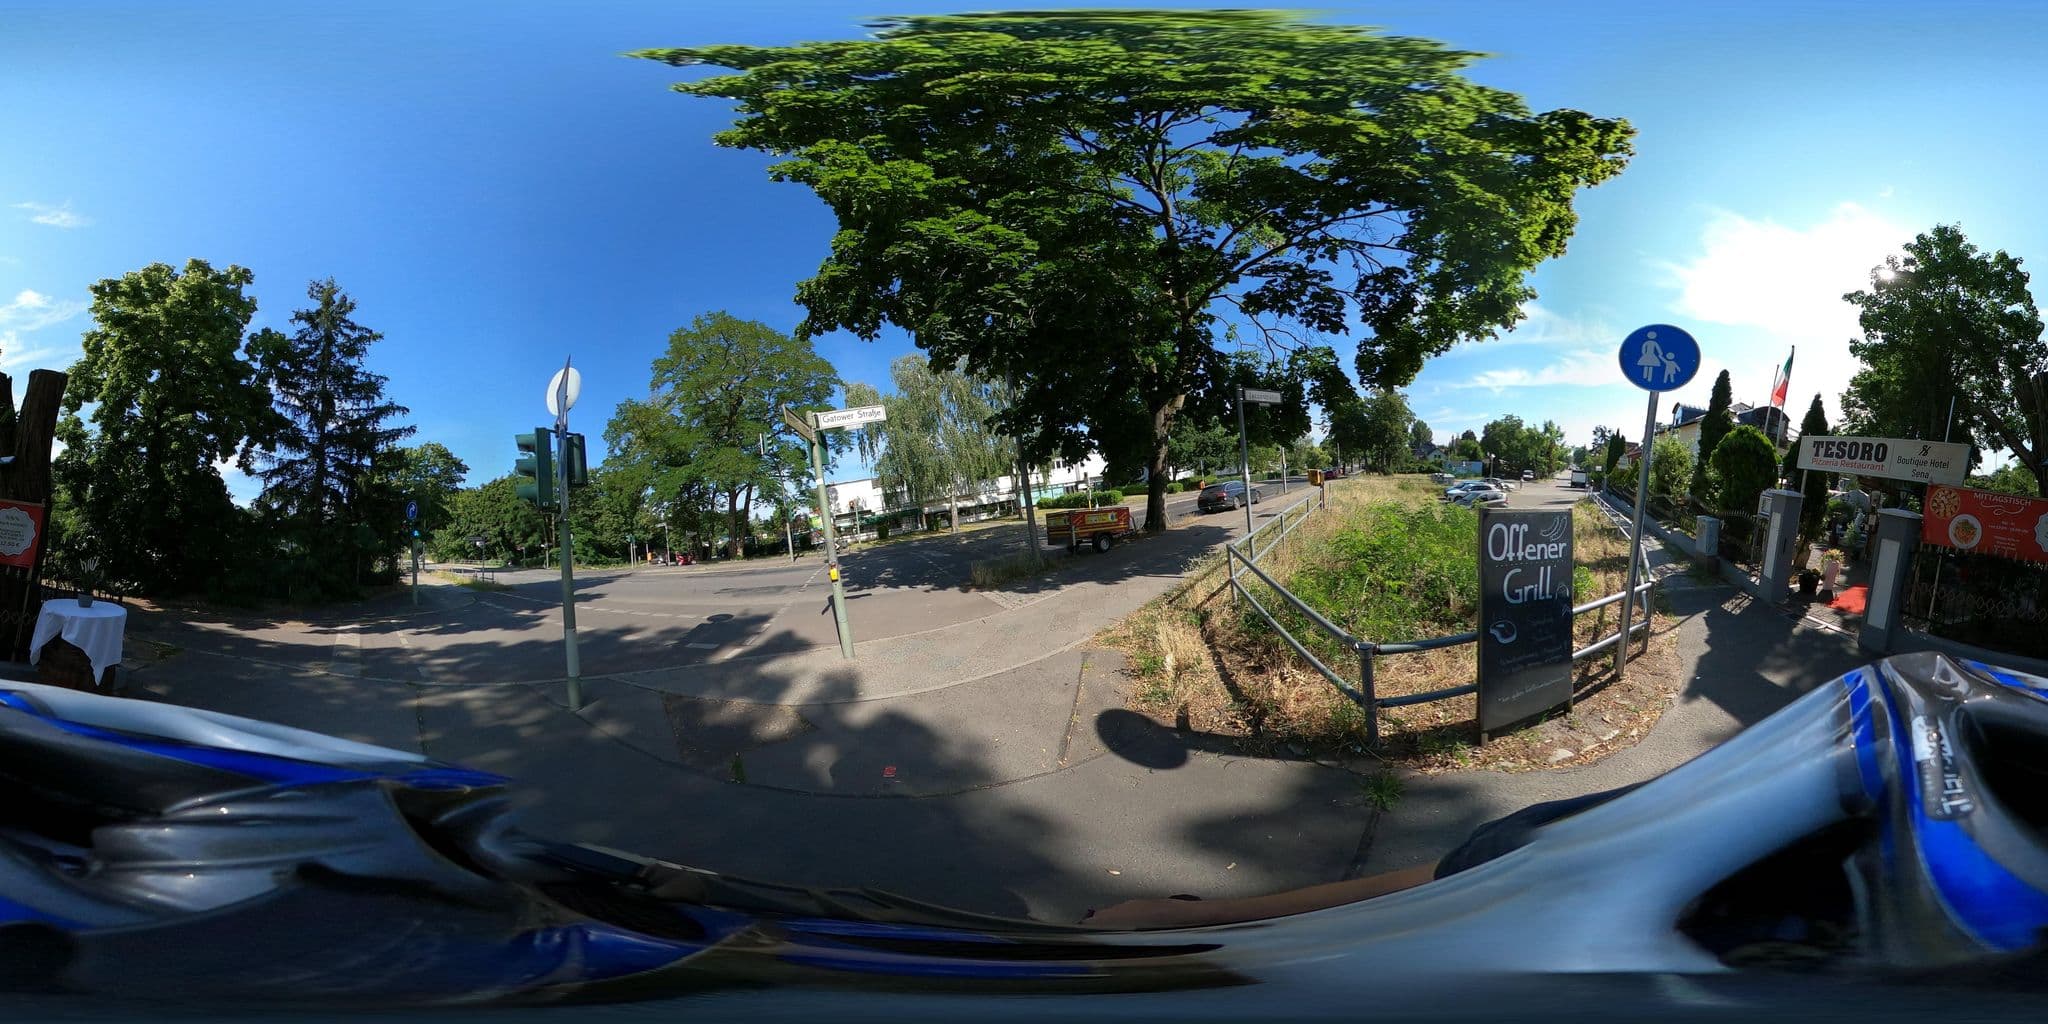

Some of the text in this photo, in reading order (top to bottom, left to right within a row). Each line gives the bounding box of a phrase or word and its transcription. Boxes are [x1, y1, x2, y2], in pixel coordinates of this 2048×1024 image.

[822, 409, 881, 423] Gatower Straße
[1812, 440, 1888, 463] TESORO
[1811, 457, 1886, 472] Pizzeria Restaurant
[1896, 455, 1950, 469] Boutique Hotel
[1911, 468, 1930, 480] Sena
[1973, 492, 2032, 506] MITTAGSTISCH
[1488, 522, 1567, 562] Offener
[1503, 566, 1553, 604] Grill
